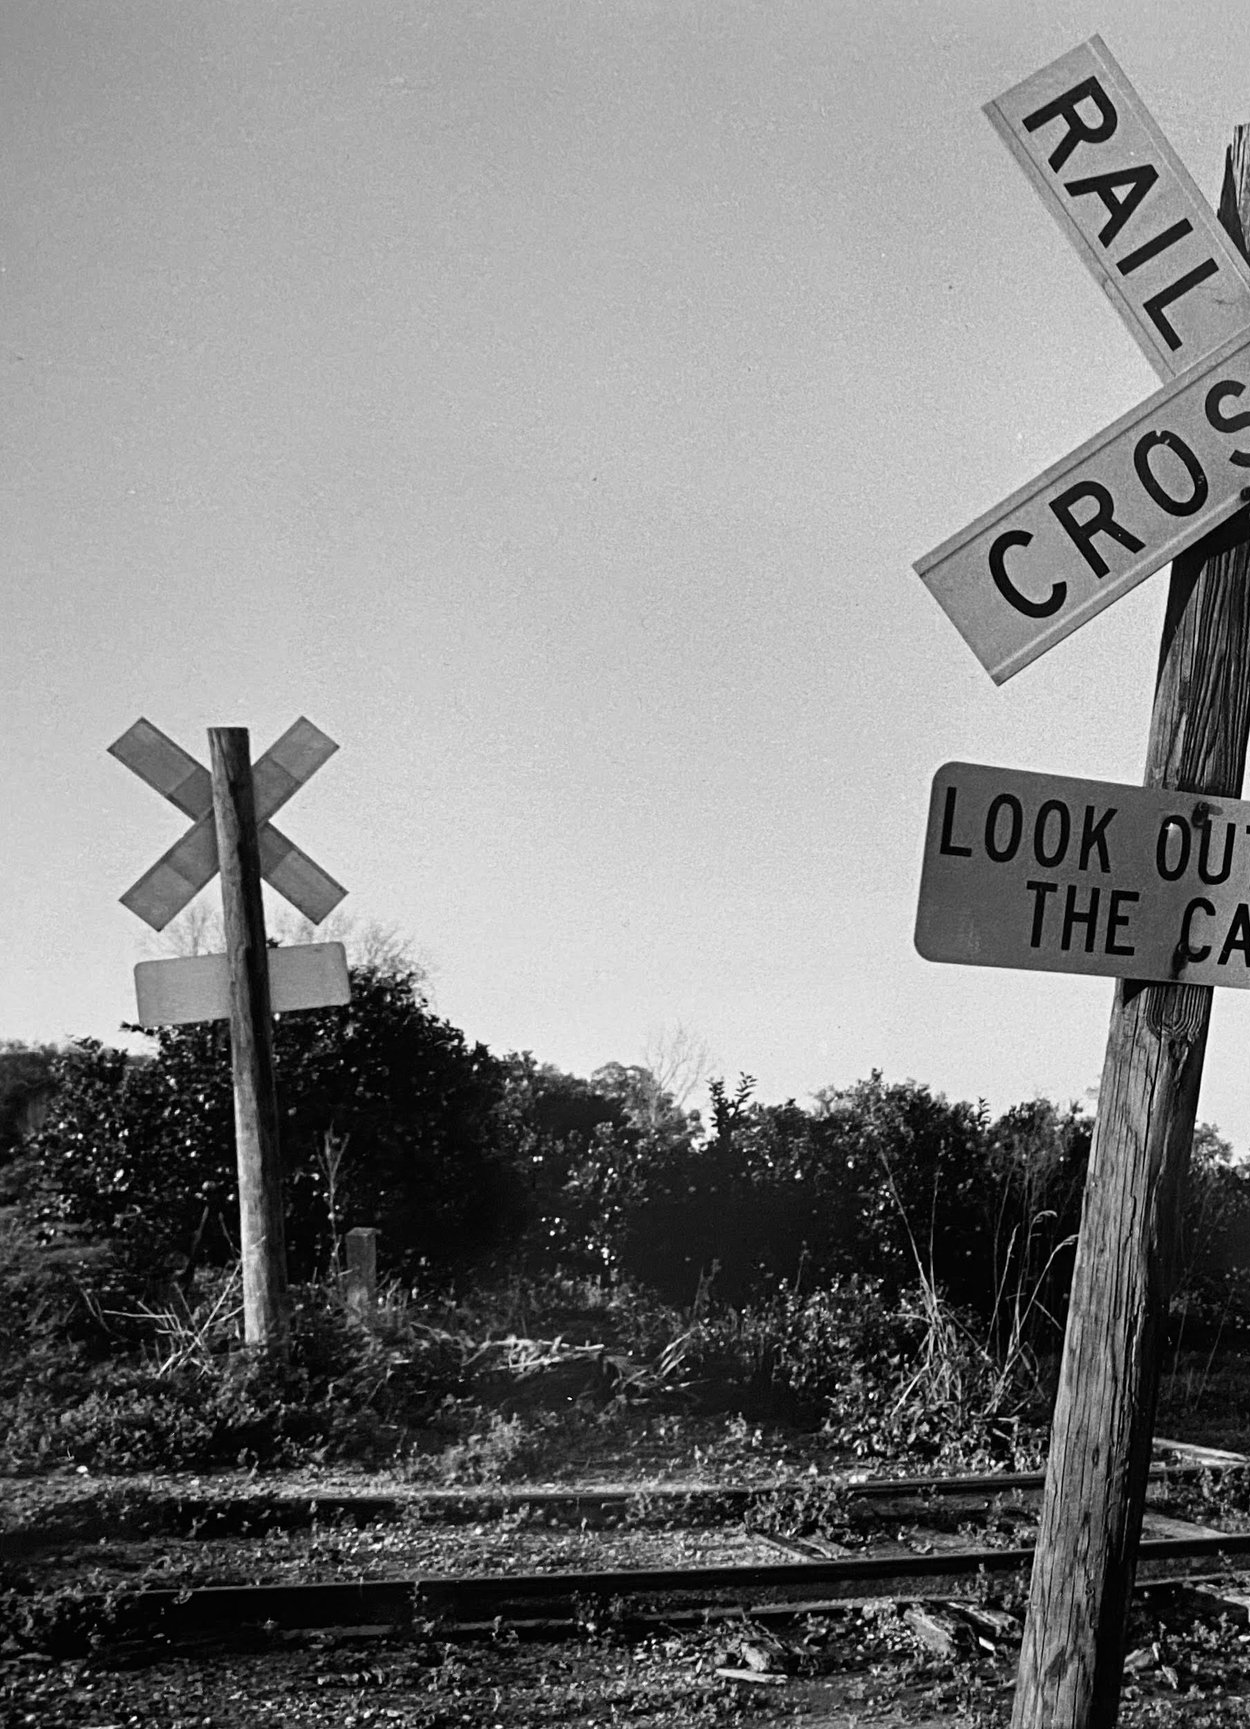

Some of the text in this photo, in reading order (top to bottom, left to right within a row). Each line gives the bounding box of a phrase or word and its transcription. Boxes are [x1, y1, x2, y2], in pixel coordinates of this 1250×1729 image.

[1022, 75, 1220, 353] RAIL
[939, 786, 1118, 873] LOOK
[1026, 880, 1140, 956] THE
